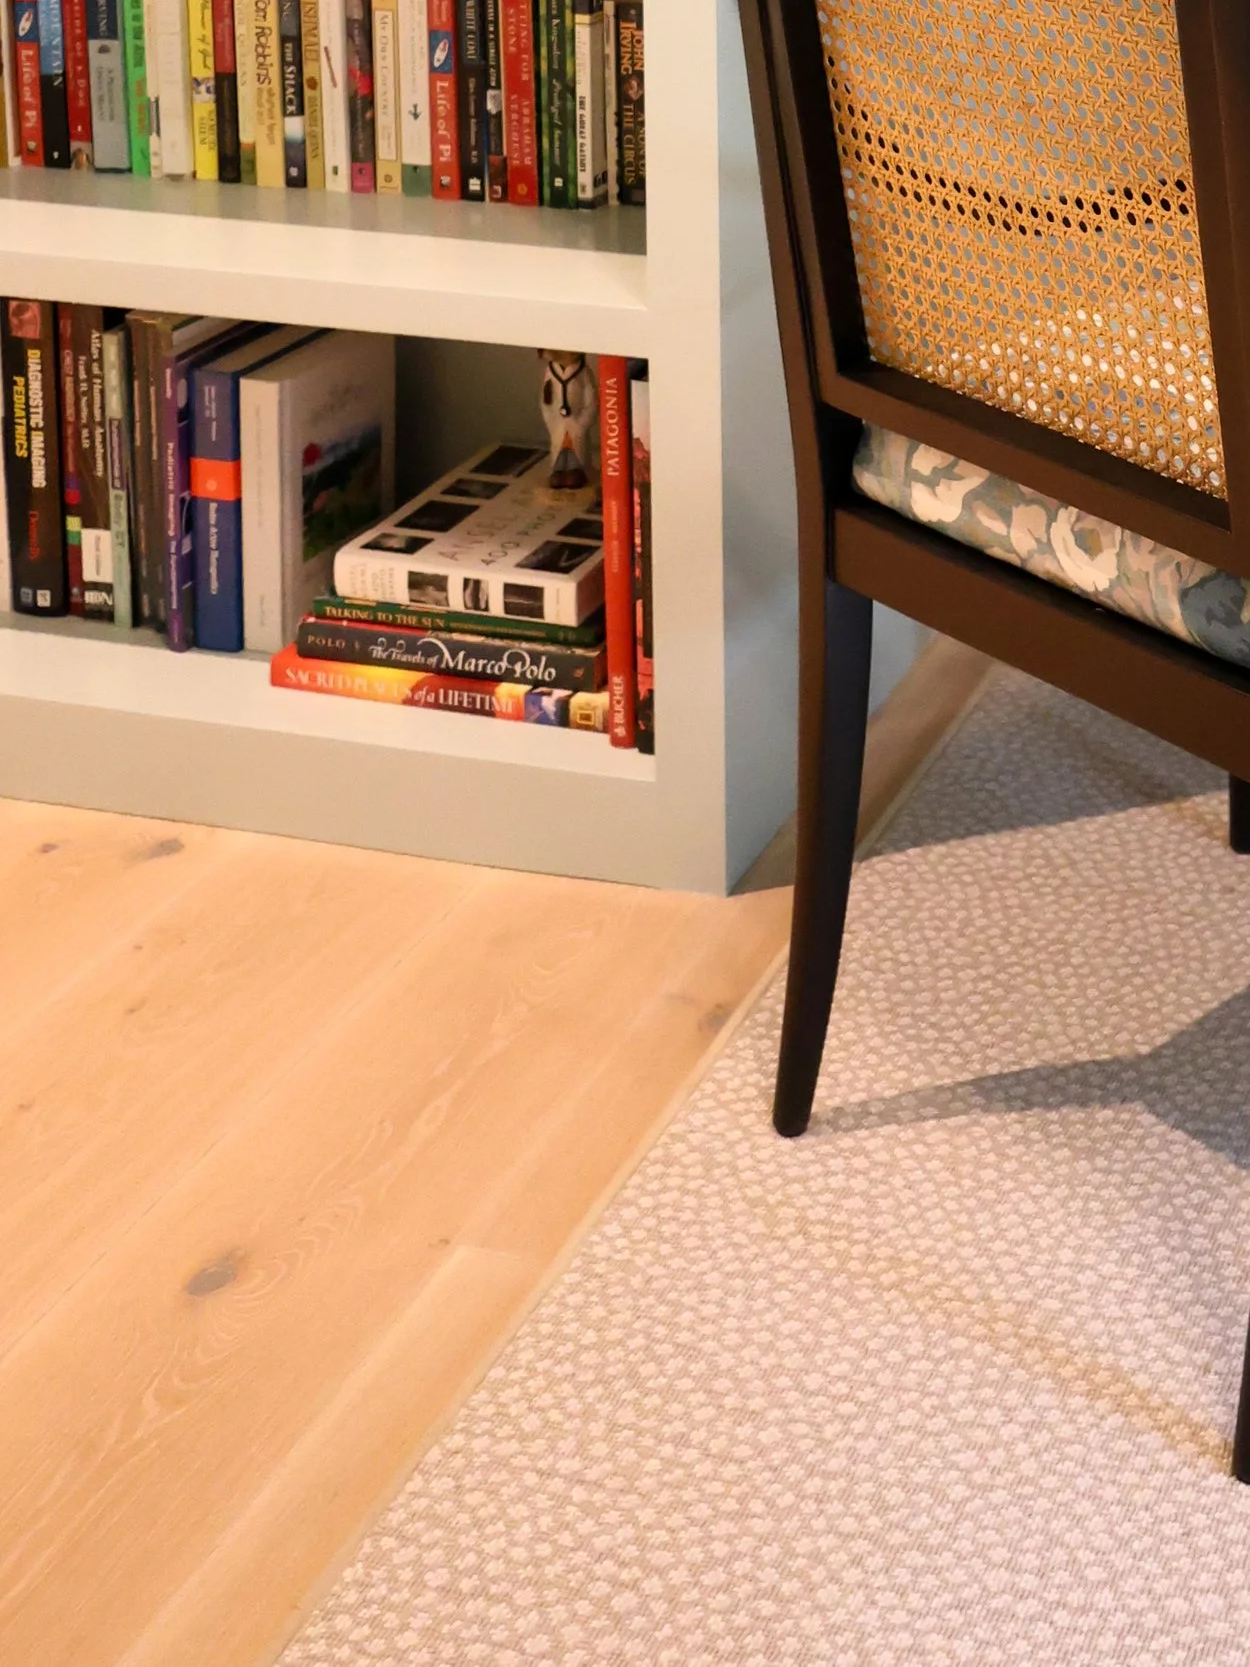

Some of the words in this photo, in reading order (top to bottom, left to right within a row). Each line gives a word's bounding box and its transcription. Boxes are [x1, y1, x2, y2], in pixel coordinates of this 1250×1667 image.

[303, 1, 319, 63] ISHMAEL
[465, 0, 476, 32] WHITE
[507, 7, 516, 54] STONE
[254, 26, 274, 86] Robbins
[285, 43, 293, 62] THE
[466, 35, 477, 60] COAT
[619, 22, 635, 75] IRVING
[631, 28, 645, 71] JOHN
[20, 50, 35, 83] Life
[520, 54, 530, 81] FOR
[23, 86, 35, 103] of
[284, 65, 297, 115] SHACK
[436, 80, 450, 116] Life
[24, 110, 38, 127] Pi
[437, 119, 450, 139] of
[510, 93, 520, 167] VERGHESE
[522, 99, 531, 166] ABRAHAM
[623, 104, 634, 130] THE
[439, 143, 452, 162] Pi
[623, 134, 635, 185] CIRCUS
[89, 330, 101, 360] Atlas
[91, 363, 103, 375] of
[27, 348, 43, 428] DIAGNOSTIC
[92, 378, 104, 422] Human
[12, 375, 28, 459] PEDIATRICS
[606, 377, 620, 476] PATAGONIA
[30, 431, 46, 488] IMAGING
[92, 425, 105, 477] Anatomy
[324, 605, 374, 622] TALKING
[377, 613, 394, 622] TO
[396, 613, 420, 626] THE
[422, 616, 445, 628] SUN
[307, 635, 346, 649] POLO
[368, 637, 389, 660] The
[384, 640, 425, 665] Travels
[417, 638, 508, 676] Marco
[426, 654, 438, 669] of
[503, 648, 556, 682] Polo
[437, 688, 517, 714] LIFETIME
